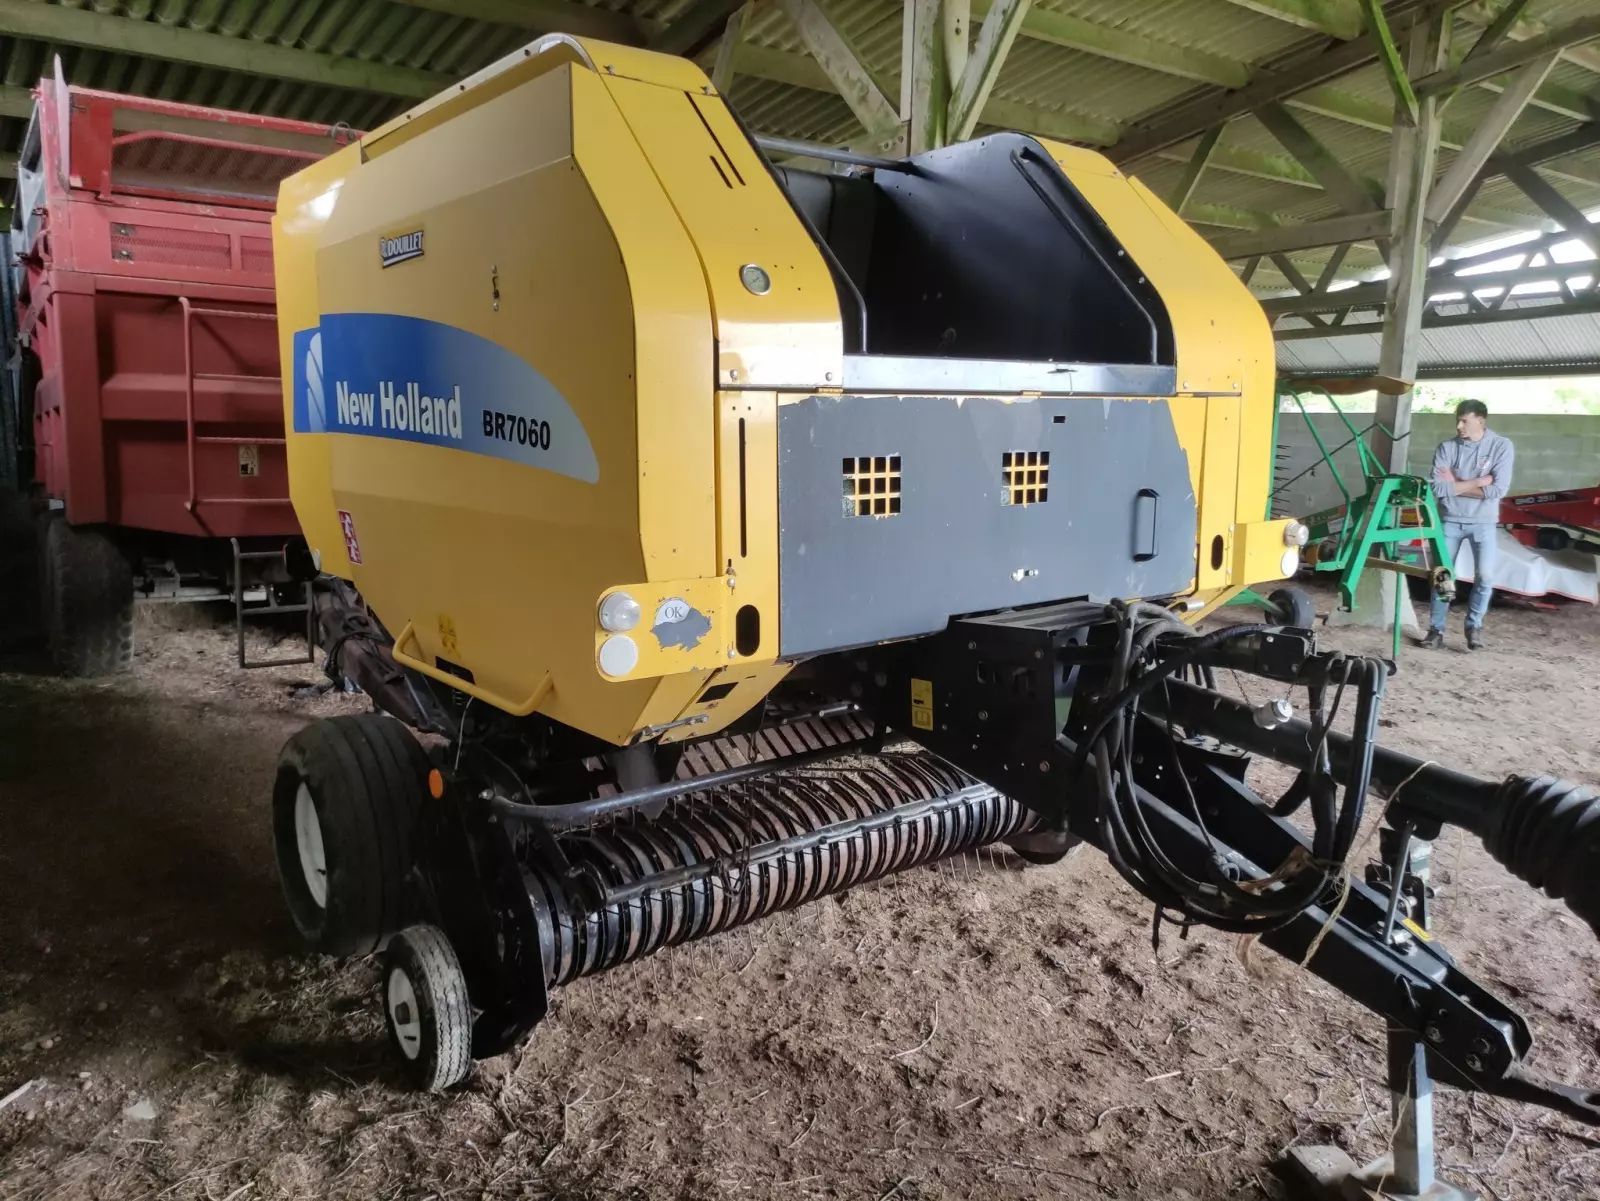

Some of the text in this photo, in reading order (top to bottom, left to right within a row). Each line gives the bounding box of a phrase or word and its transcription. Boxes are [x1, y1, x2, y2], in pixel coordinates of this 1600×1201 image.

[336, 381, 463, 440] New Holland
[482, 409, 551, 451] BR7060
[664, 606, 684, 619] OK
